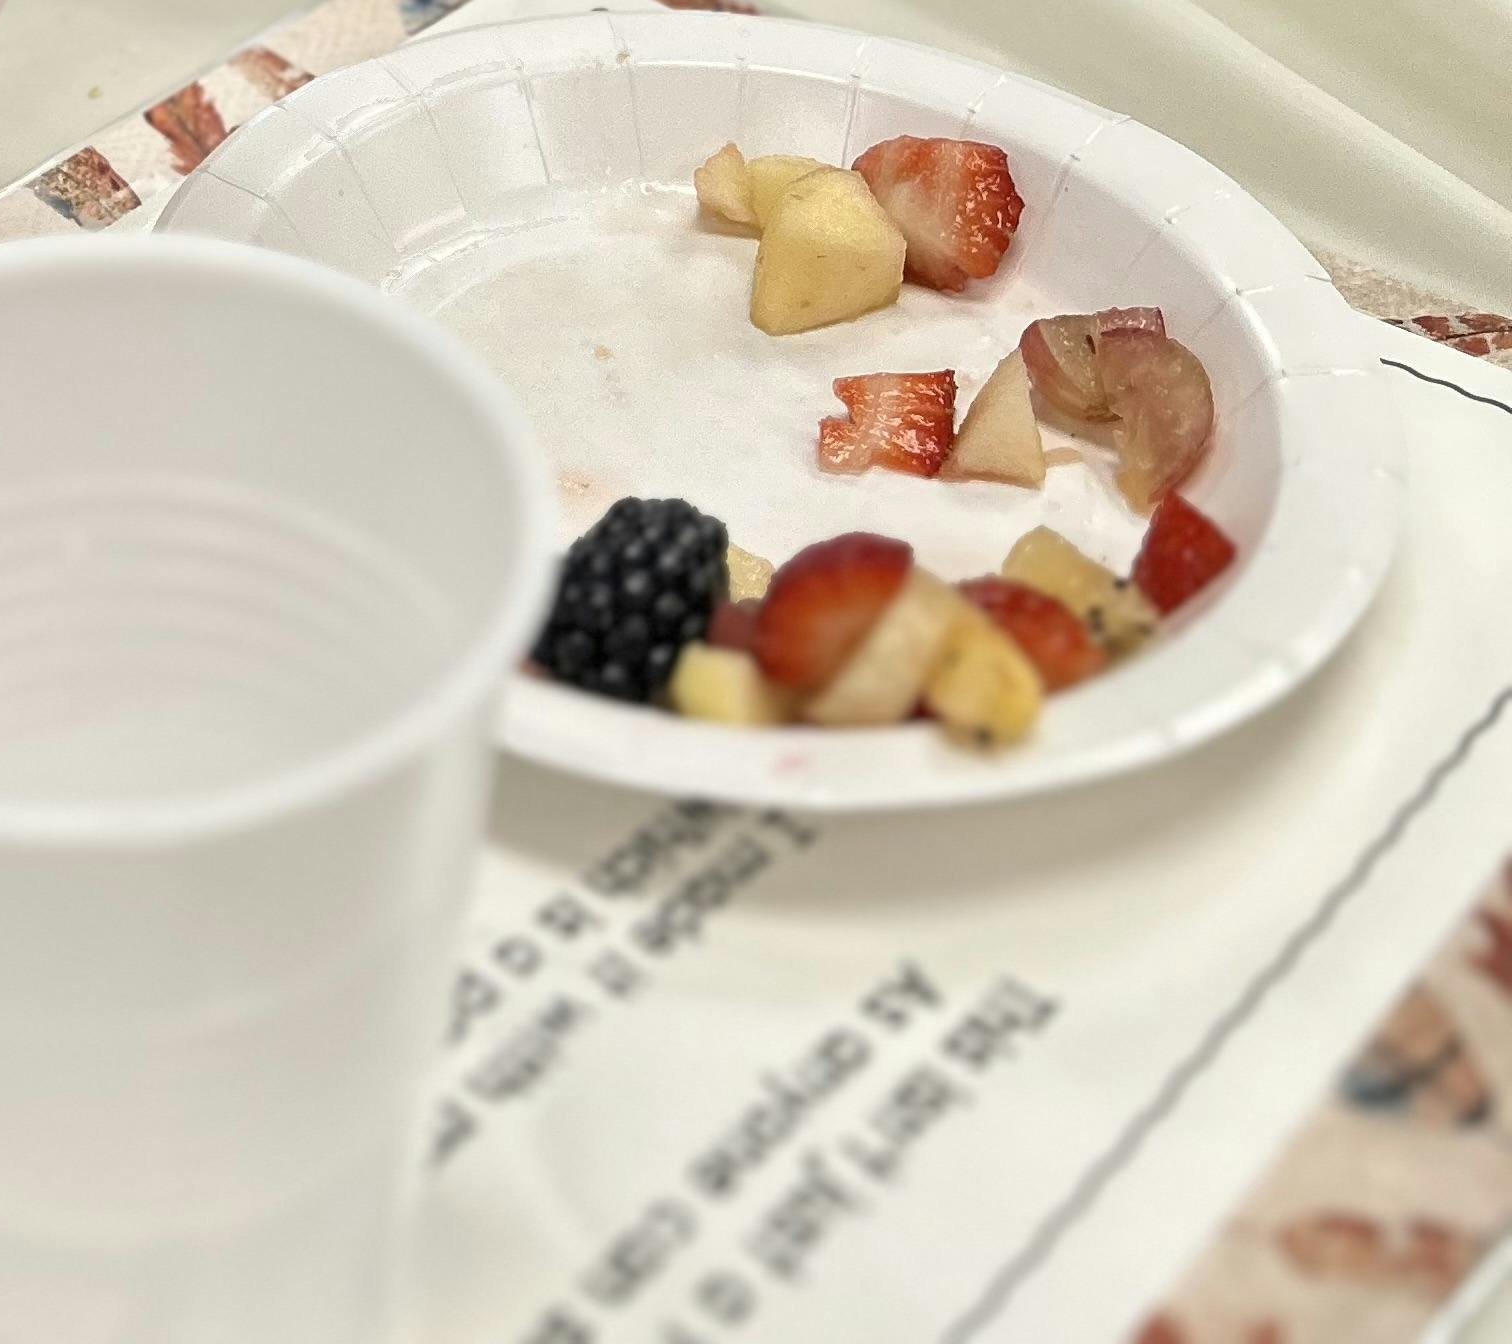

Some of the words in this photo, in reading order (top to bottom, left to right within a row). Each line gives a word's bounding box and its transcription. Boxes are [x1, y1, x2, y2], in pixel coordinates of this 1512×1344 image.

[758, 809, 817, 850] I
[534, 891, 606, 940] is
[631, 835, 773, 957] made
[491, 934, 543, 978] a
[588, 947, 648, 999] it
[858, 957, 943, 1030] As
[464, 997, 596, 1102] with
[938, 973, 1063, 1073] This
[688, 1026, 872, 1198] anyone
[580, 1199, 697, 1306] can
[743, 1148, 872, 1285] just
[693, 1269, 756, 1327] a
